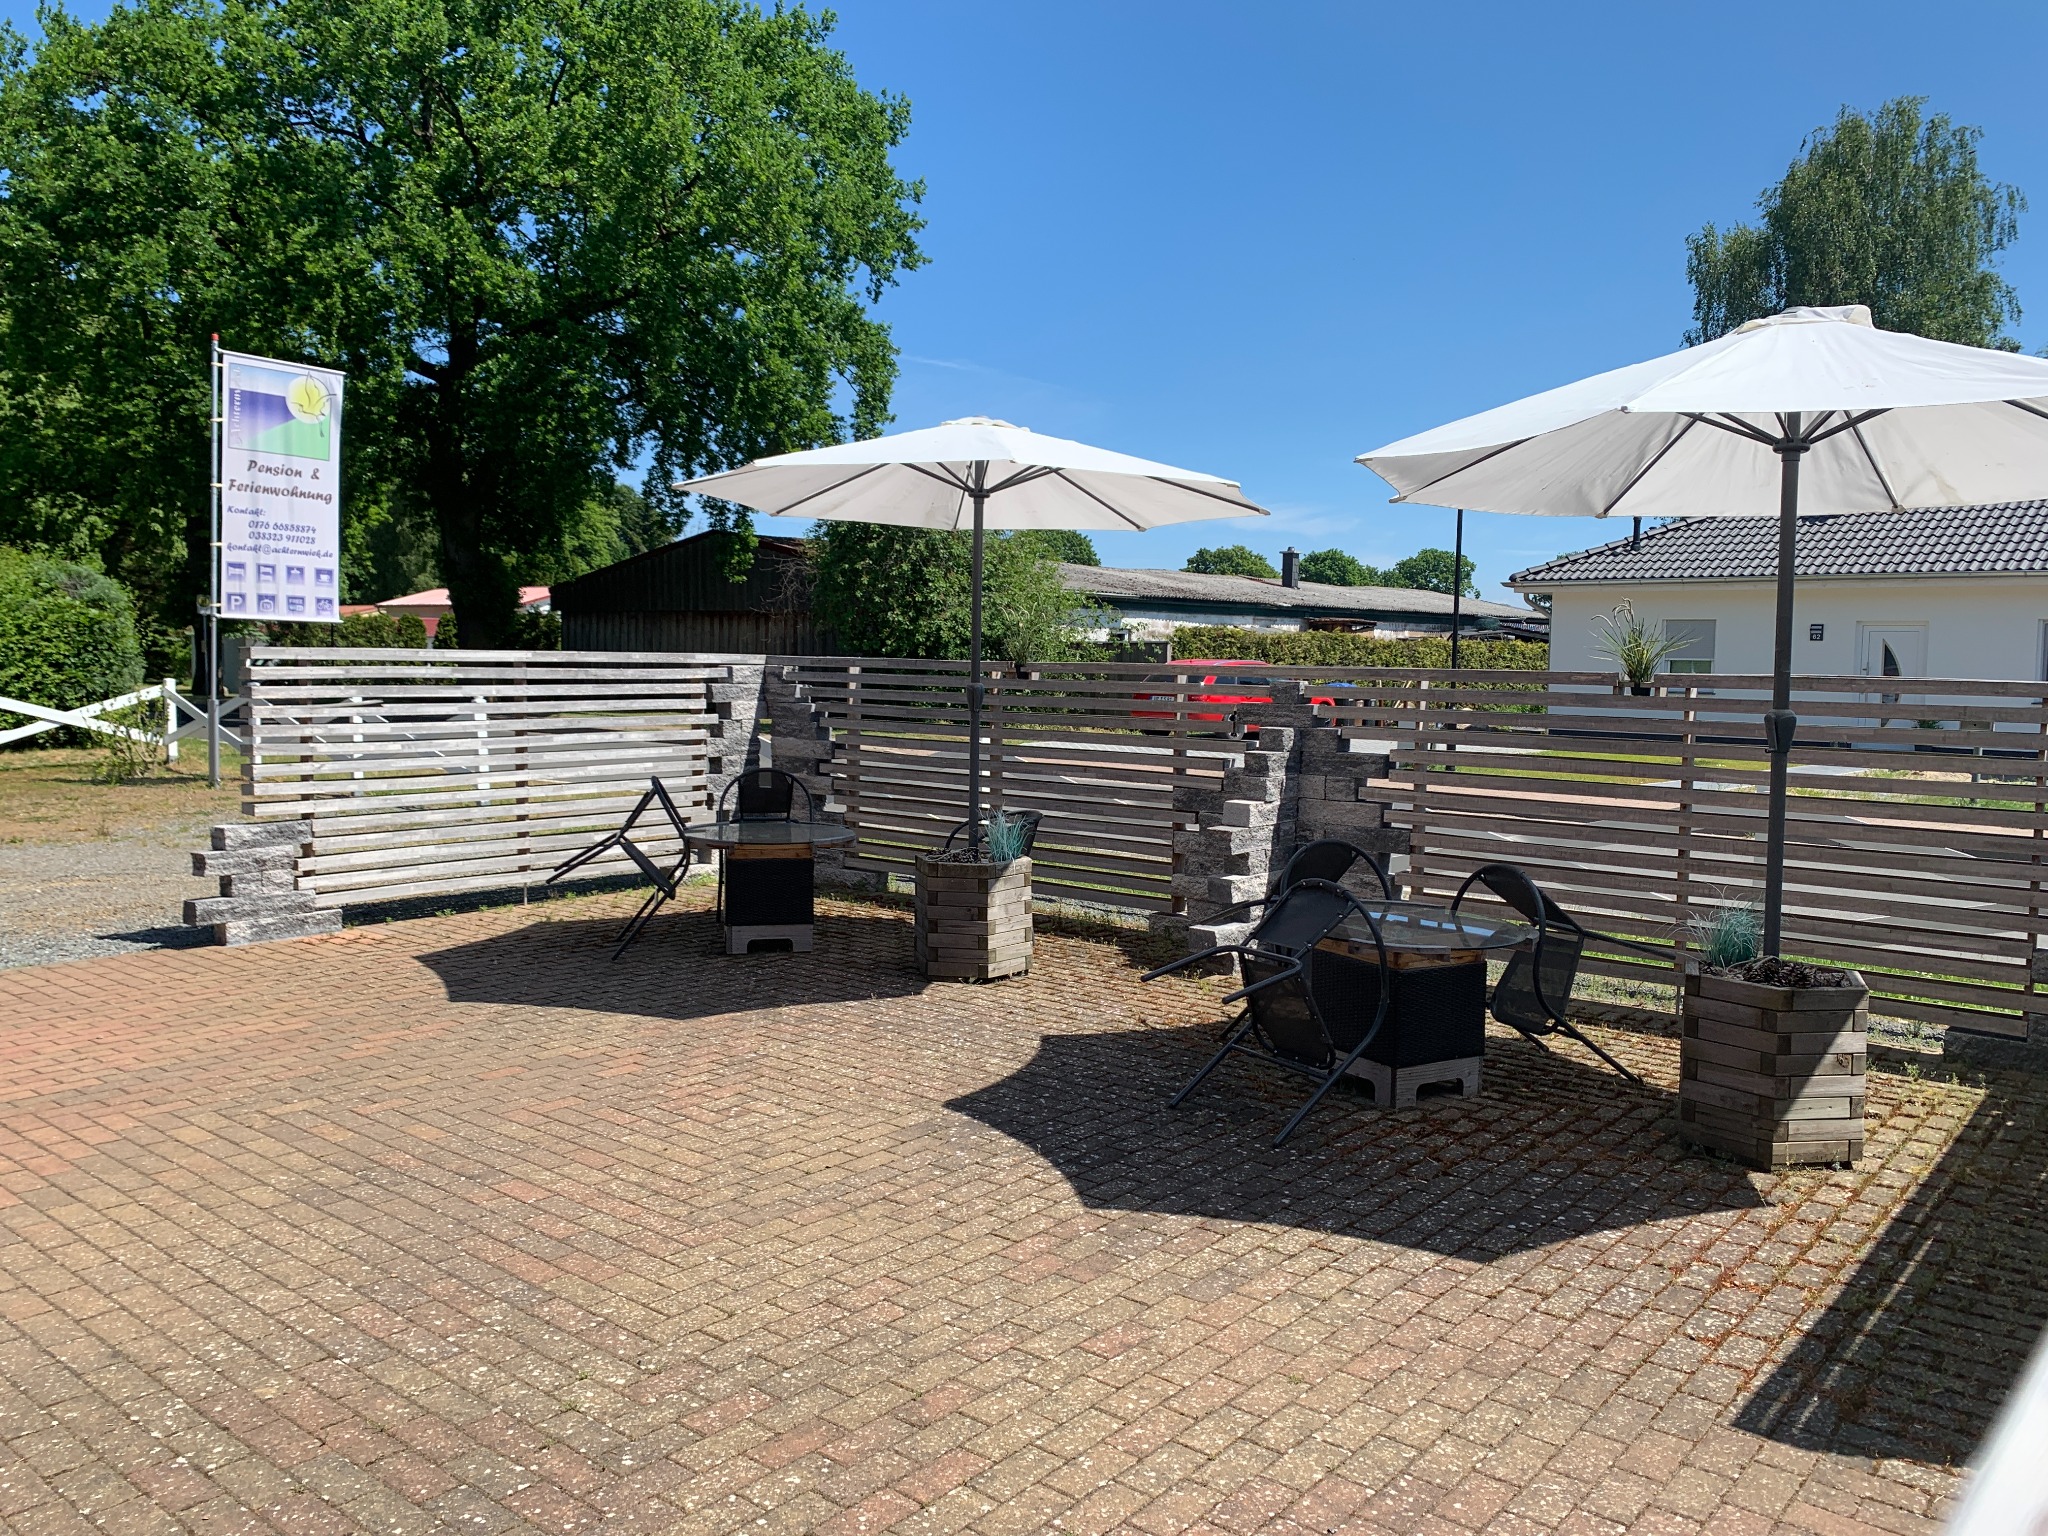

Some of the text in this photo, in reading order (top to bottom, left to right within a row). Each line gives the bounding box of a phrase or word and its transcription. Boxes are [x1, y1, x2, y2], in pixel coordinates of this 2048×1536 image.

[247, 460, 320, 480] Pension &
[228, 478, 333, 505] Ferienwohnung
[227, 505, 266, 517] Kontakt:
[248, 520, 270, 530] 0176
[248, 531, 316, 545] 038323 911028
[227, 542, 333, 559] kontakt@achternwiek.de
[231, 595, 243, 610] P
